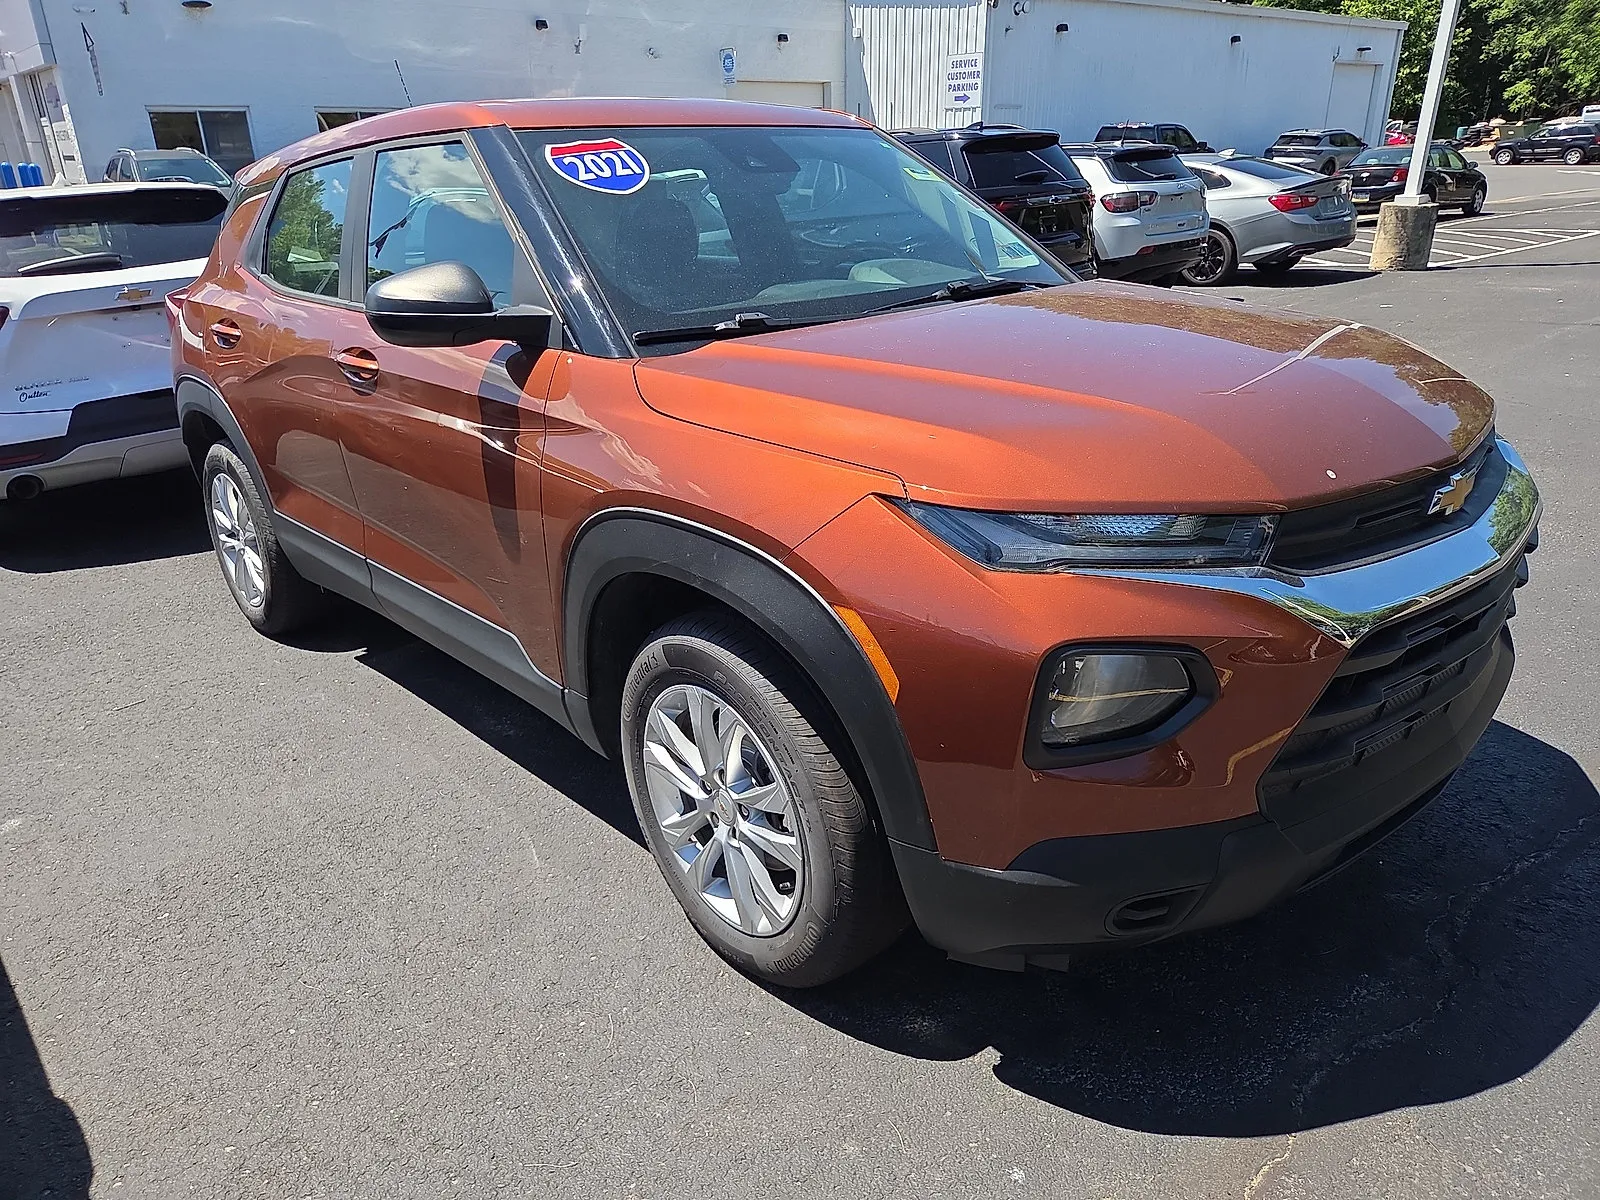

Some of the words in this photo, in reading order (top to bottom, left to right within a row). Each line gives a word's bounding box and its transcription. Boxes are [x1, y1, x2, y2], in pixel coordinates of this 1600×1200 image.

[951, 58, 978, 69] SERVICE
[947, 70, 981, 81] CUSTOMER
[947, 82, 979, 92] PARKING
[562, 151, 644, 181] 2021
[623, 655, 654, 722] Continental
[773, 920, 823, 974] Continental
